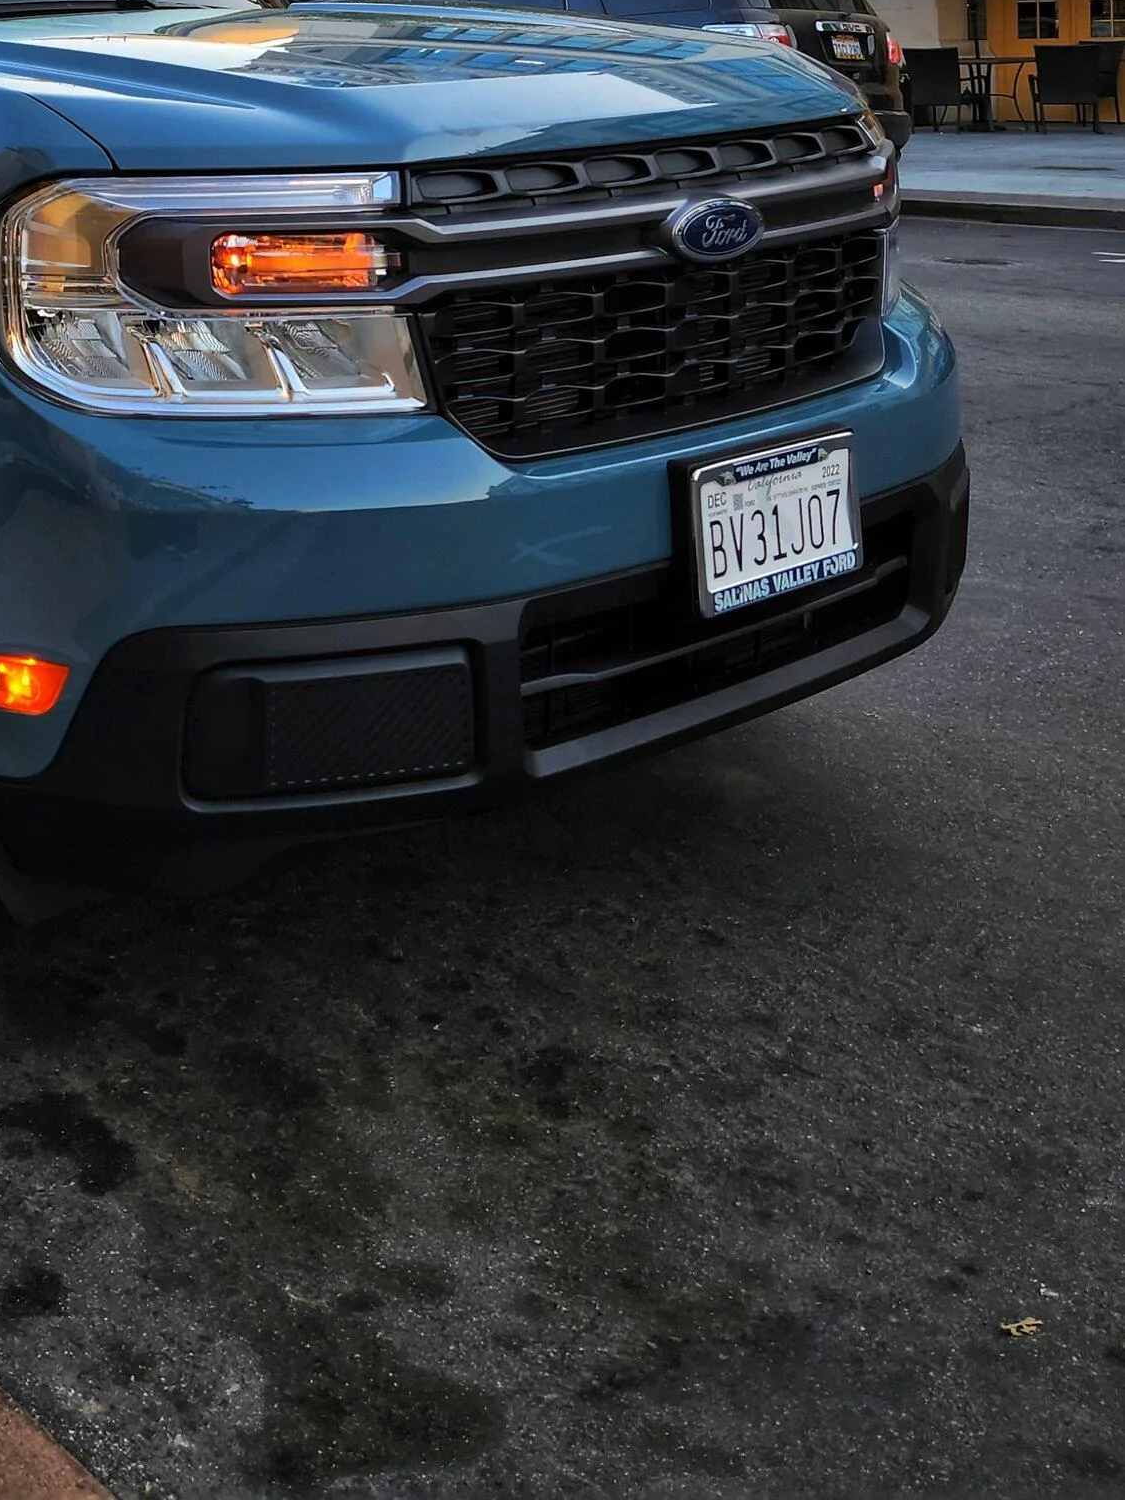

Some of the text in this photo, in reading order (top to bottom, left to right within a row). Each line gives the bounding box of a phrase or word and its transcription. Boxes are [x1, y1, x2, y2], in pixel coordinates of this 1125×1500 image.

[701, 213, 748, 248] Ford
[755, 462, 769, 473] Are
[769, 457, 786, 469] The
[822, 463, 840, 478] 2022
[708, 491, 727, 509] DEC
[714, 551, 856, 612] SALINAS VALLEY FORD
